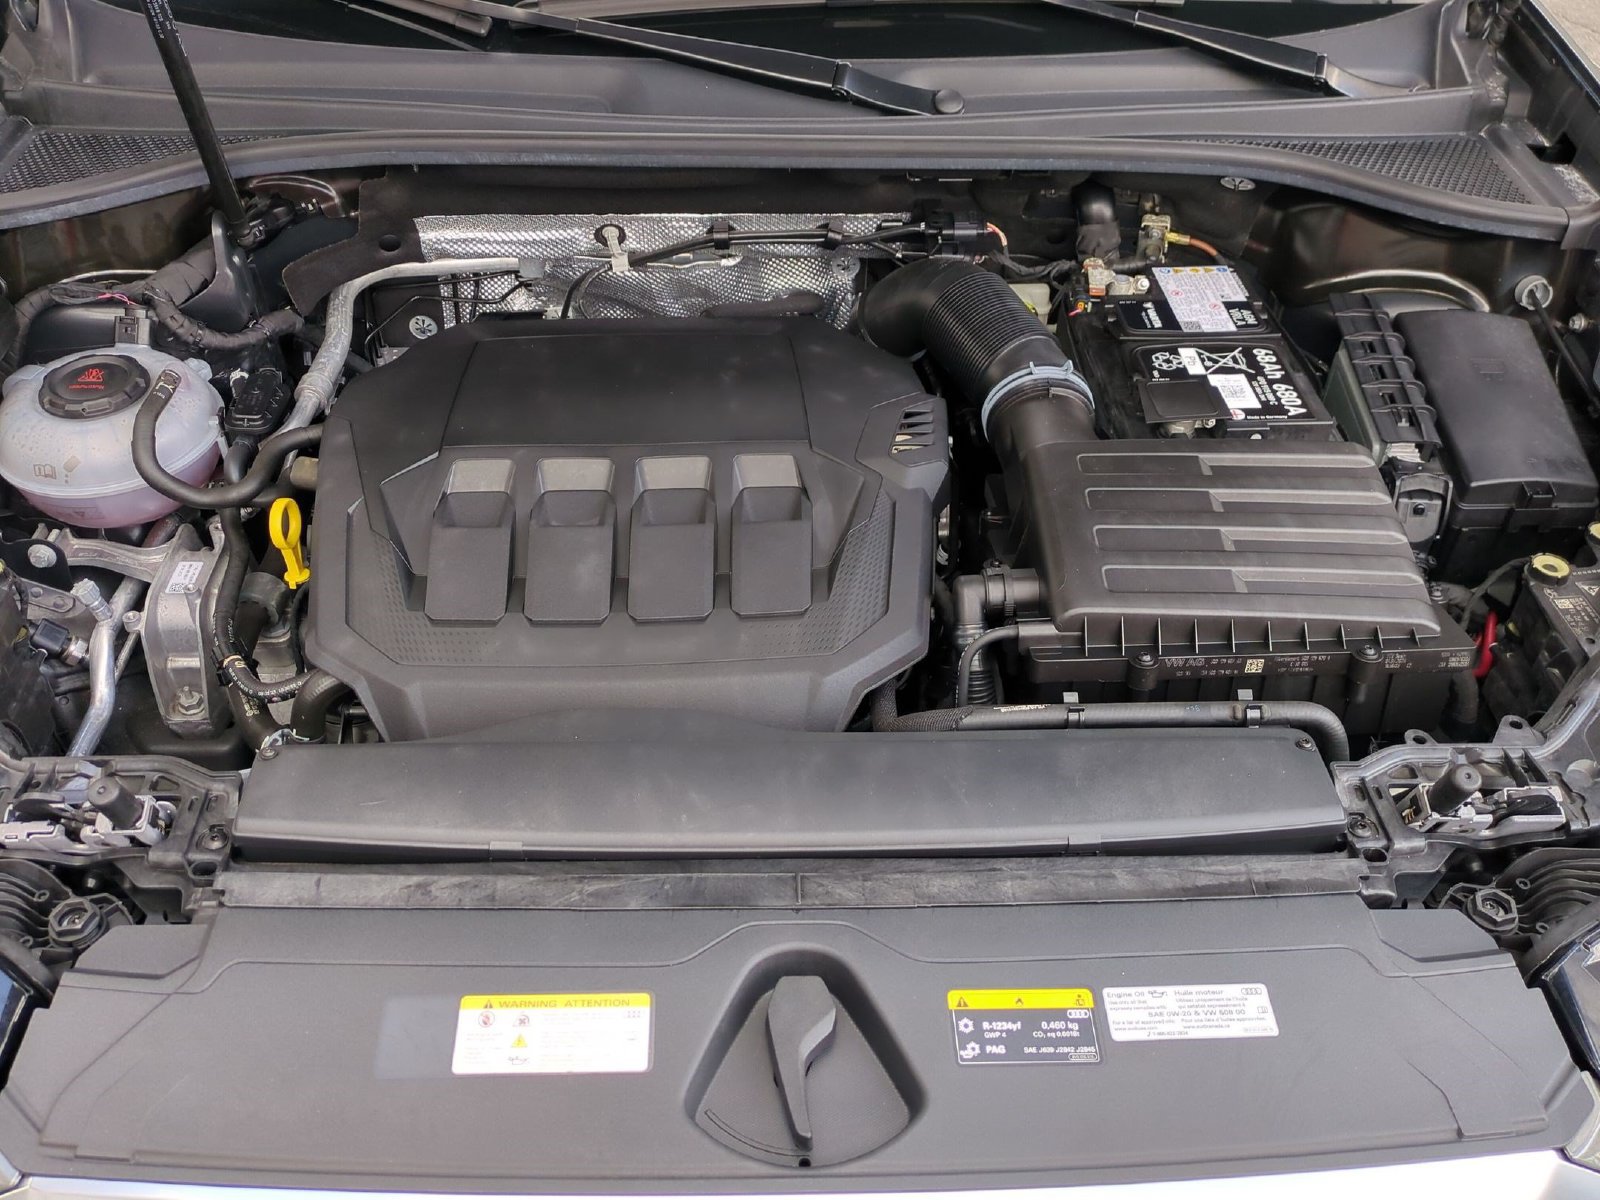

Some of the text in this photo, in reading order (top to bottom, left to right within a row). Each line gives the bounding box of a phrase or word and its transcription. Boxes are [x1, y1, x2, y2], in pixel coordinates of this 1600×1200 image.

[1252, 348, 1285, 379] 68Ah
[1272, 383, 1308, 416] 680A
[1165, 658, 1186, 668] VW
[1107, 991, 1132, 999] Engine
[499, 998, 630, 1009] WARNING ATTENTION
[1148, 1010, 1164, 1018] SAE
[1067, 1020, 1079, 1031] kg
[985, 1045, 1007, 1054] PAG
